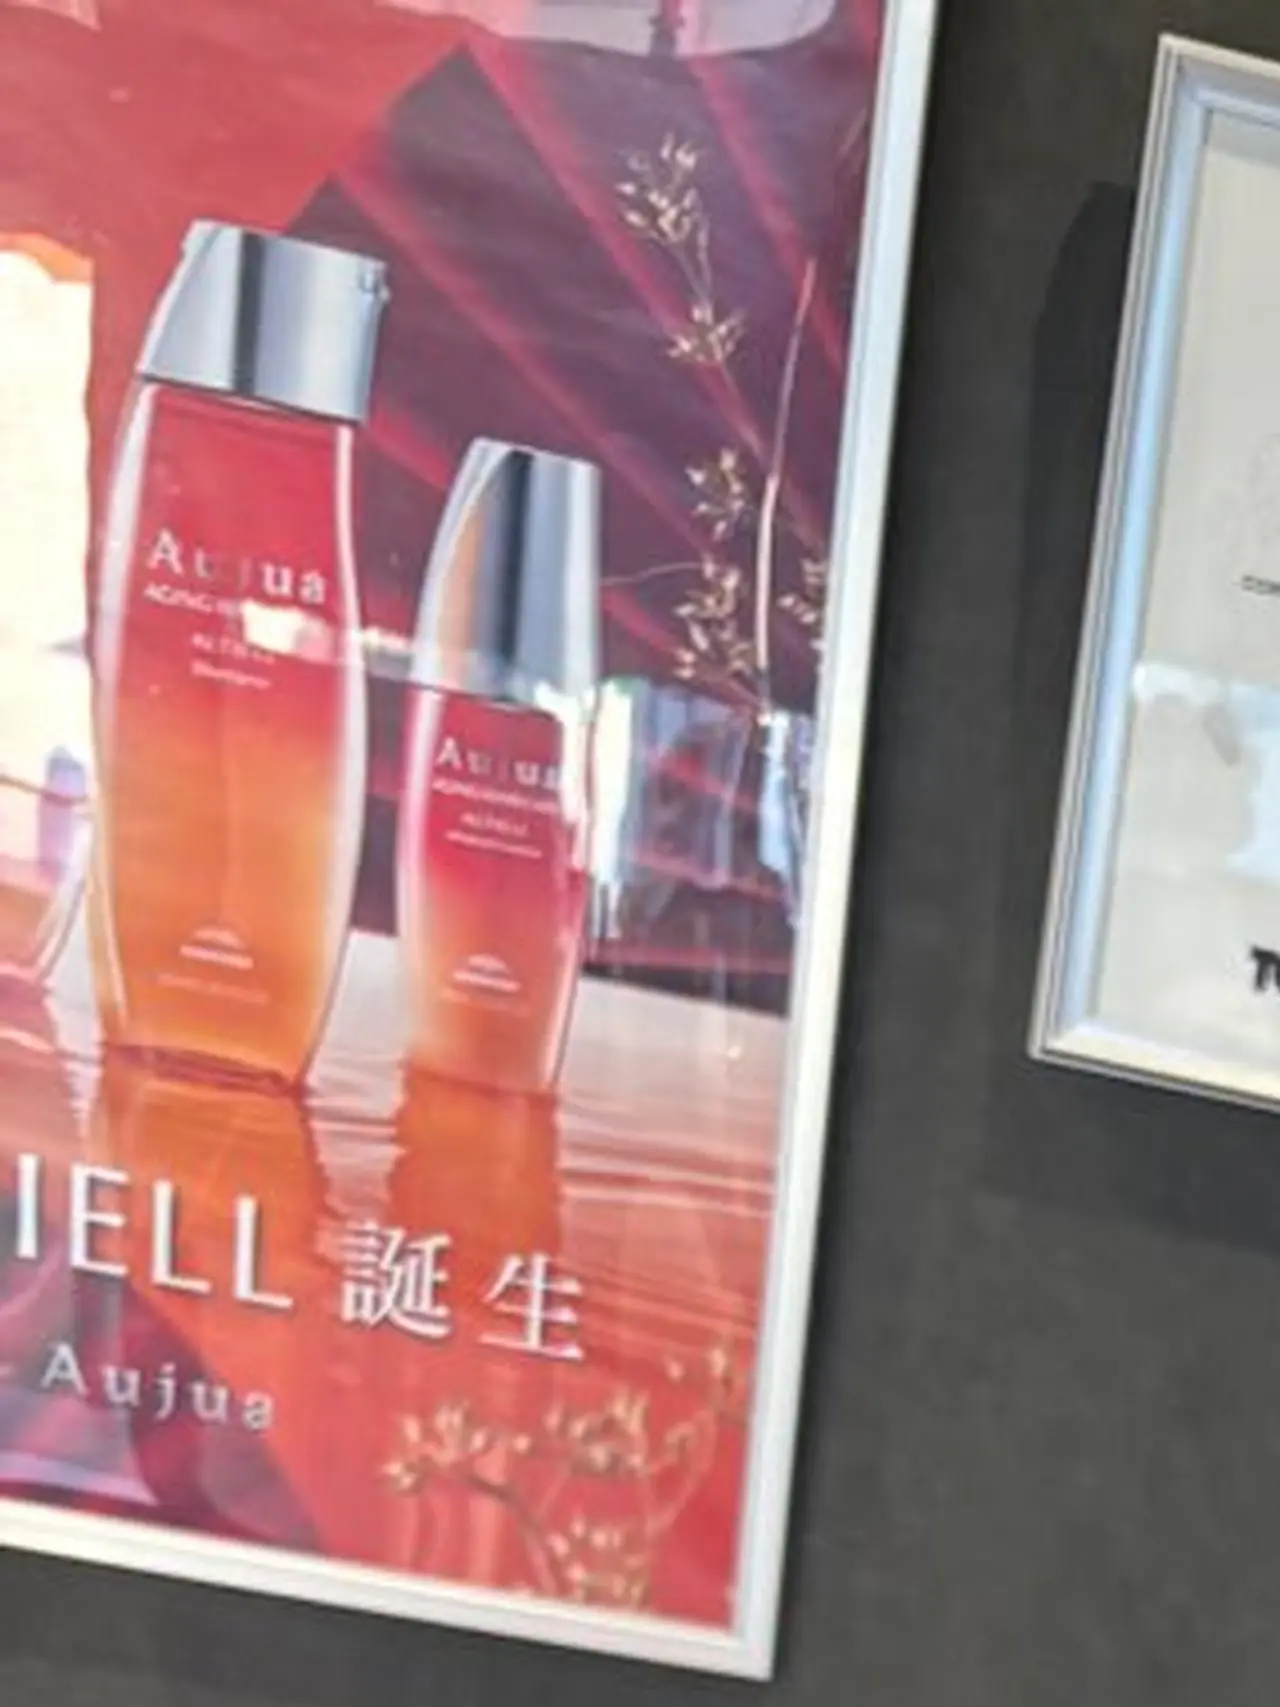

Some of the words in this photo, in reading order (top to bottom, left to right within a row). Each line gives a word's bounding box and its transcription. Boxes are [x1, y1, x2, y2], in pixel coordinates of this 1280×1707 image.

[147, 528, 327, 605] Auua
[434, 735, 561, 793] Auua
[16, 1152, 294, 1309] IELL
[339, 1218, 587, 1362] 誕生
[40, 1339, 276, 1430] Aujua
